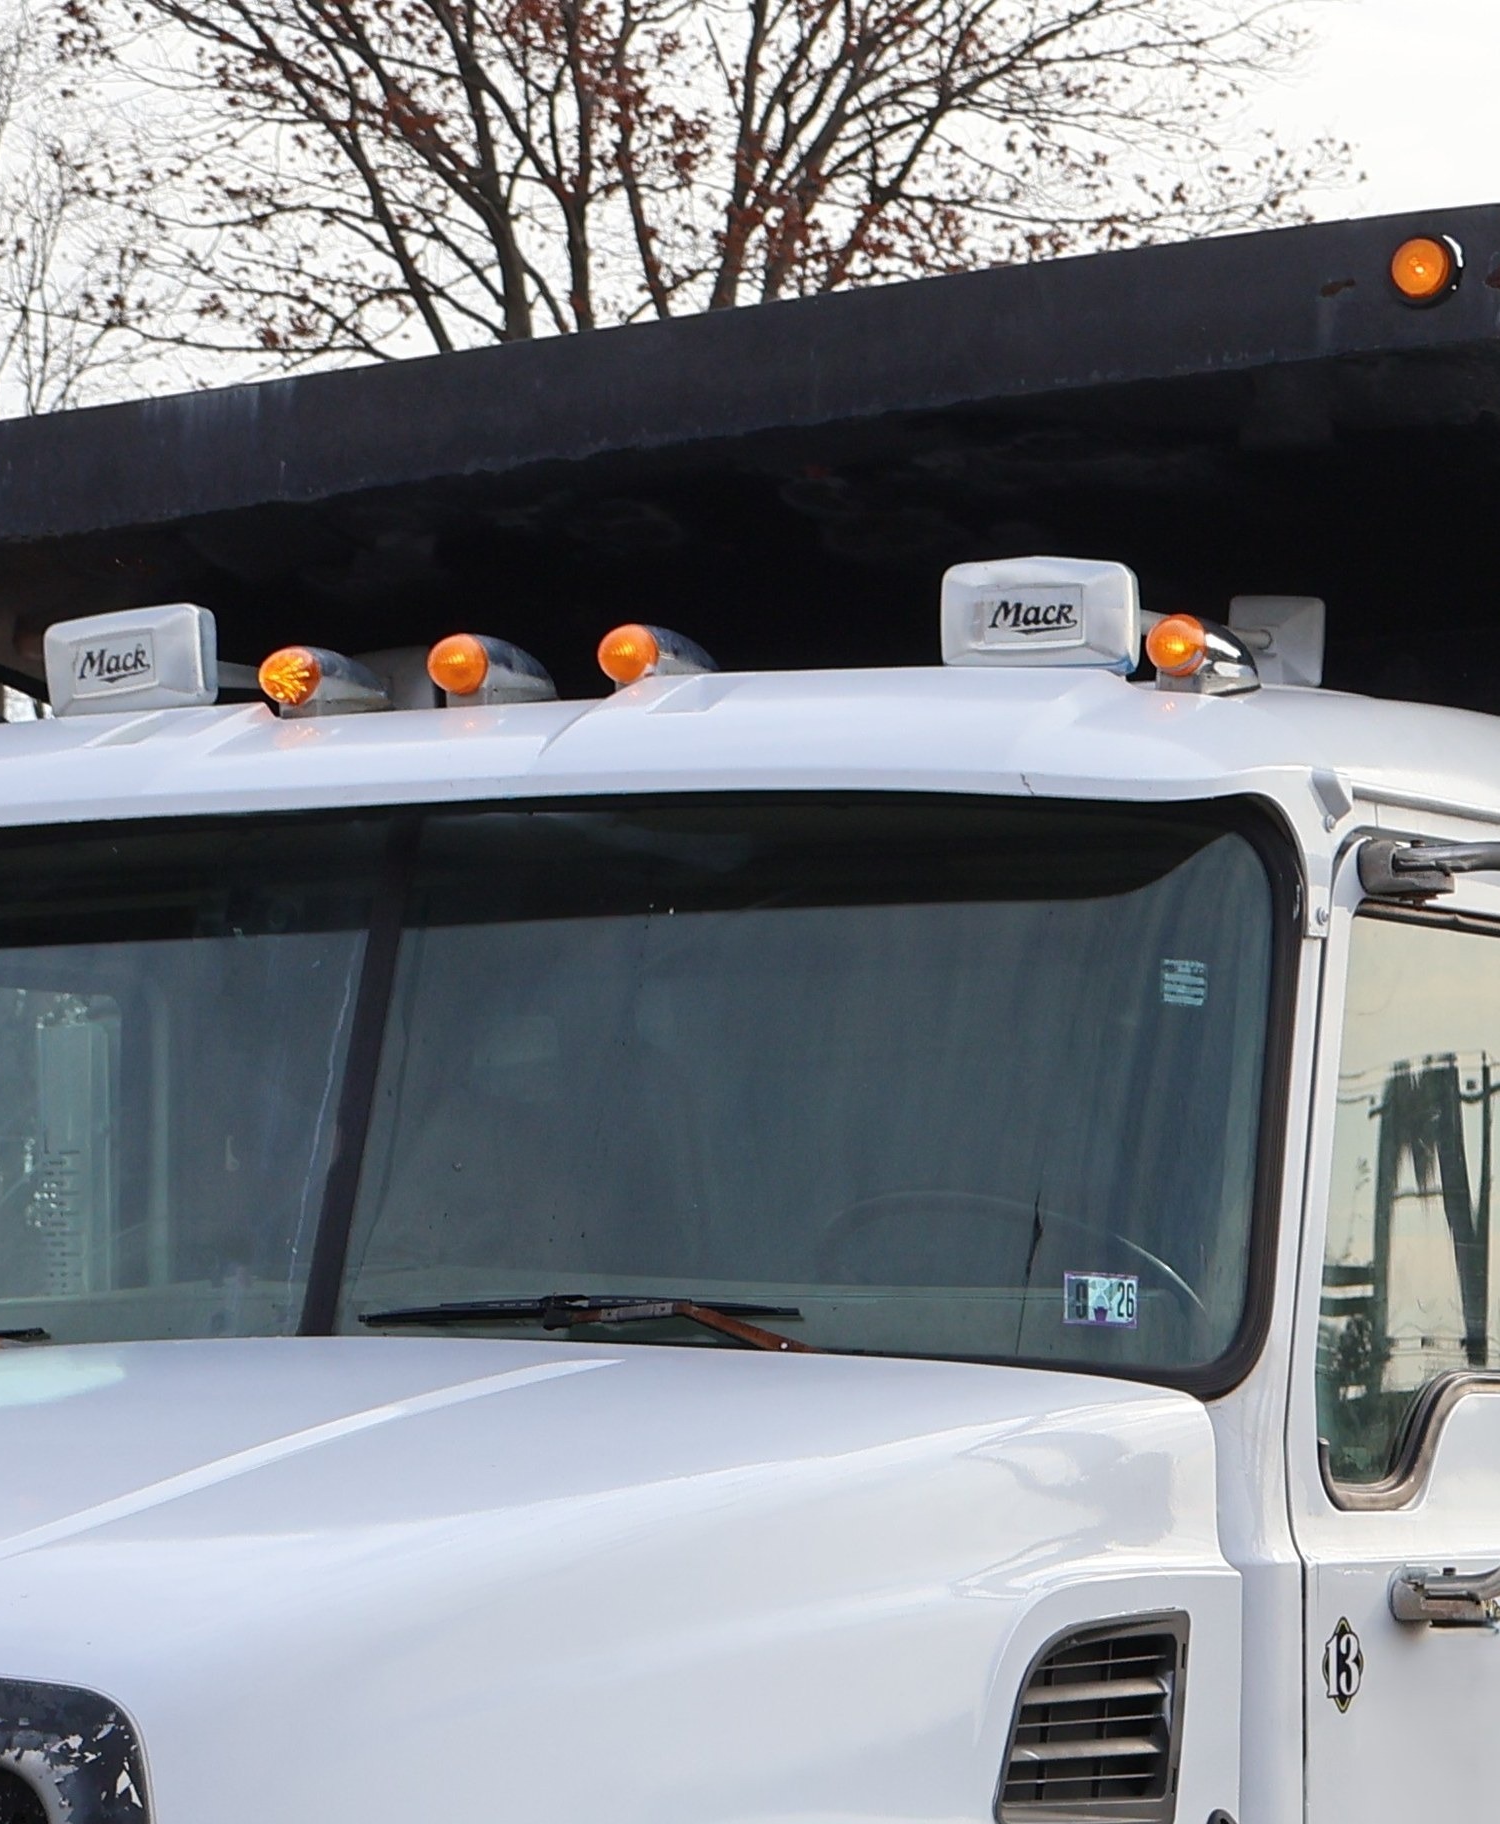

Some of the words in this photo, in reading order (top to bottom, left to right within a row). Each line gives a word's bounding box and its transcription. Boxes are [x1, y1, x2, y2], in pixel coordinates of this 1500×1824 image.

[988, 600, 1078, 635] Mack
[78, 643, 152, 683] Mack
[1116, 1281, 1135, 1318] 26
[1326, 1632, 1360, 1697] 13
